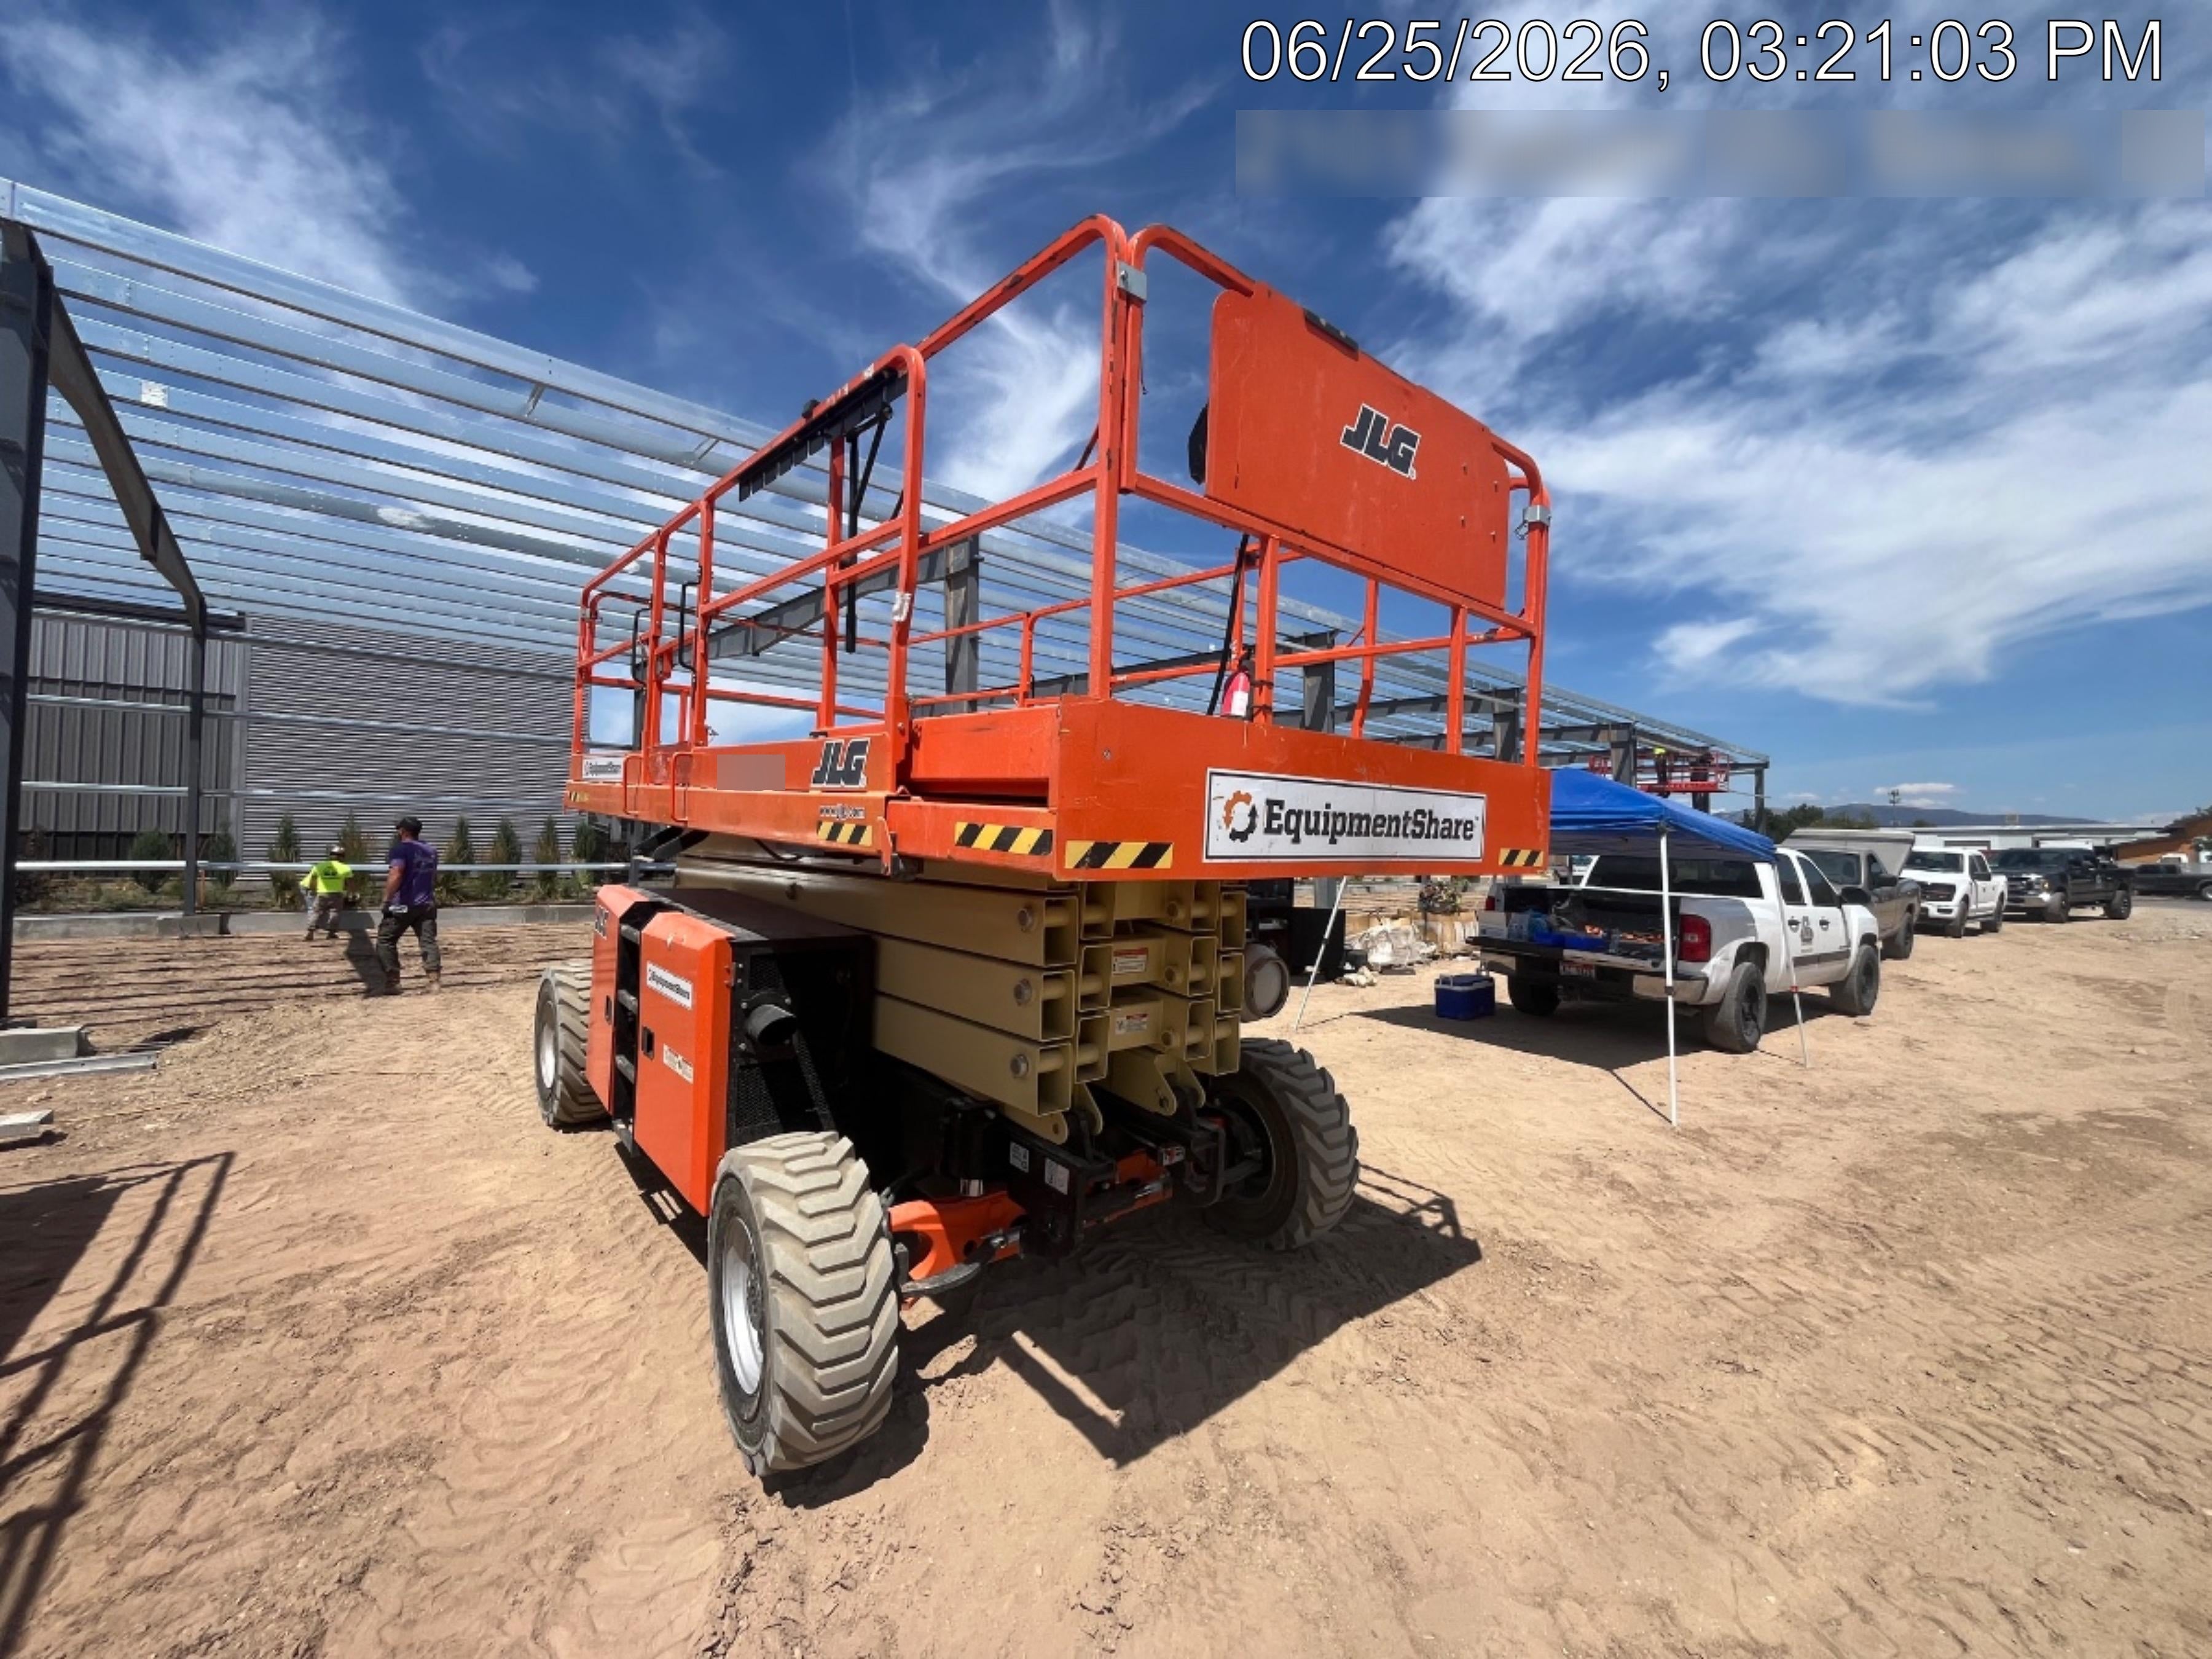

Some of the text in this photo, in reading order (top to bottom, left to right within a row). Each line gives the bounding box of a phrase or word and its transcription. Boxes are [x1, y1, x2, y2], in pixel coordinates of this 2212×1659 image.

[1340, 404, 1421, 477] JLG
[811, 738, 869, 787] JLG
[1264, 798, 1474, 844] EquipmentShare
